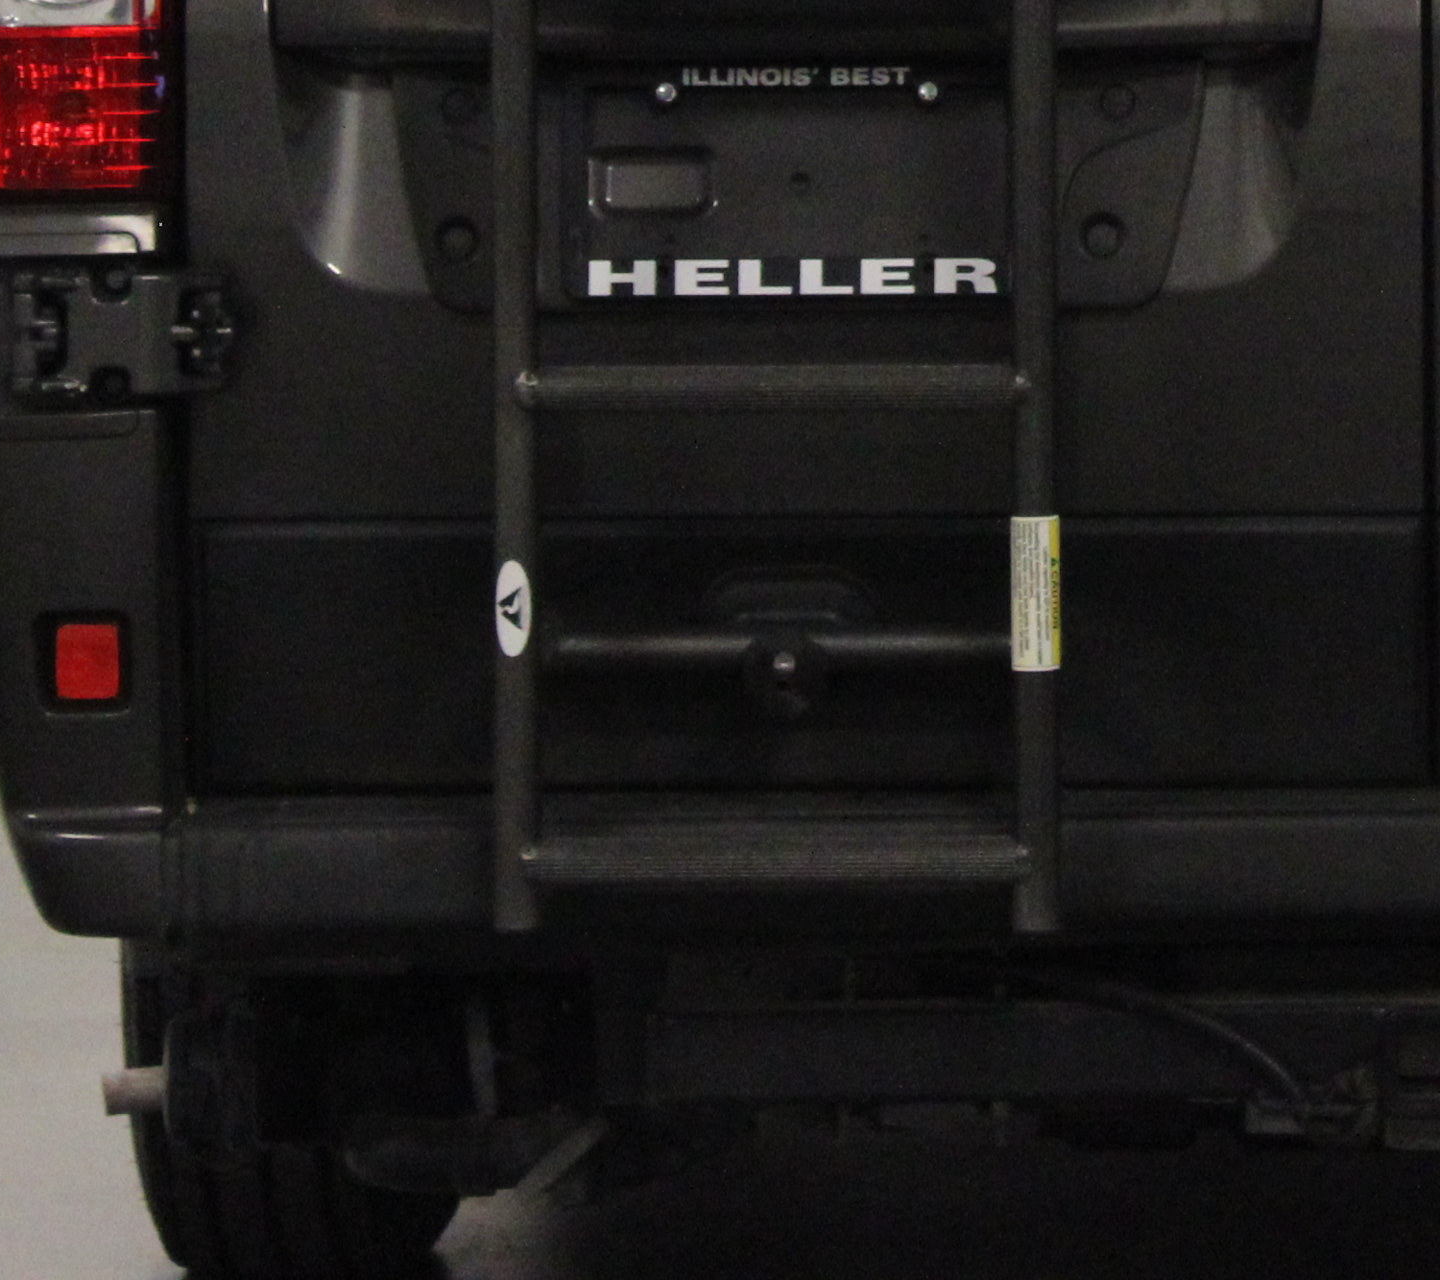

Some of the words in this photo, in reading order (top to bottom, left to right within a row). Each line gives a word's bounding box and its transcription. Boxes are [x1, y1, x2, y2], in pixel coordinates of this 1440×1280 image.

[830, 66, 910, 86] BEST
[587, 257, 999, 297] HELLER
[1050, 571, 1059, 630] CAUTION
